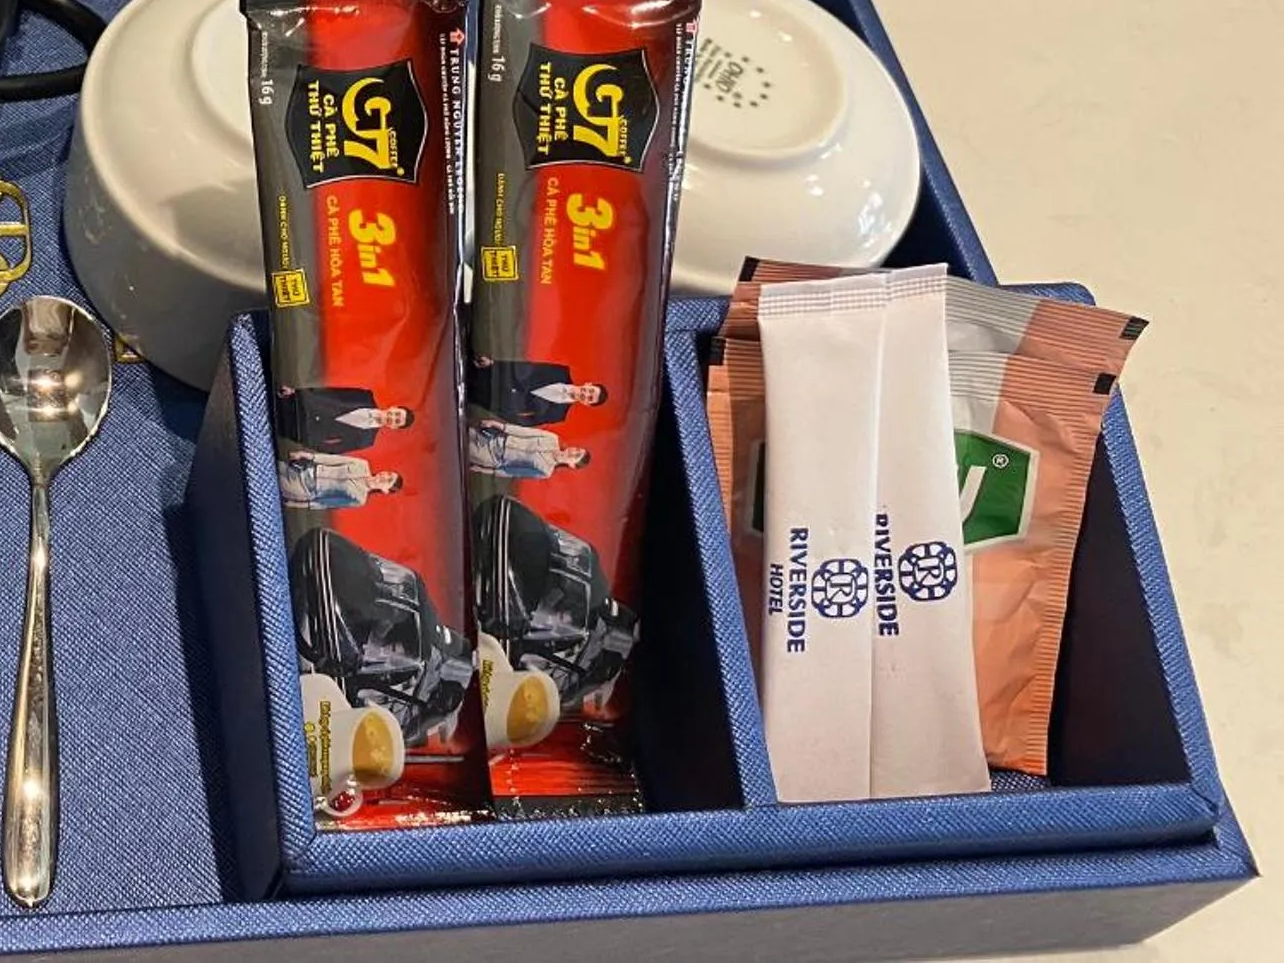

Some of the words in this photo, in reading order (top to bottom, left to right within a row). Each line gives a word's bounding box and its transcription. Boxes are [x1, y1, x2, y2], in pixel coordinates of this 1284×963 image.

[449, 48, 461, 95] TRUNG
[491, 55, 506, 71] 16
[261, 79, 274, 94] 16
[539, 62, 554, 98] THỨ
[554, 77, 567, 100] CÀ
[308, 80, 324, 117] THỨ
[324, 94, 336, 118] CÀ
[572, 64, 624, 158] G7
[342, 77, 391, 171] G7
[536, 104, 552, 155] THIỆT
[554, 107, 568, 140] PHÊ
[308, 121, 325, 173] THIỆT
[324, 123, 339, 158] PHÊ
[547, 177, 560, 197] CÀ
[326, 195, 340, 215] CÀ
[544, 199, 558, 226] PHÊ
[327, 217, 341, 245] PHÊ
[542, 228, 555, 257] HÒA
[566, 193, 614, 270] 3in1
[330, 248, 343, 279] HÒA
[348, 208, 398, 288] 3in1
[540, 258, 553, 285] TAN
[331, 281, 344, 308] TAN
[768, 563, 784, 616] HOTEL
[786, 526, 808, 653] RIVERSIDE
